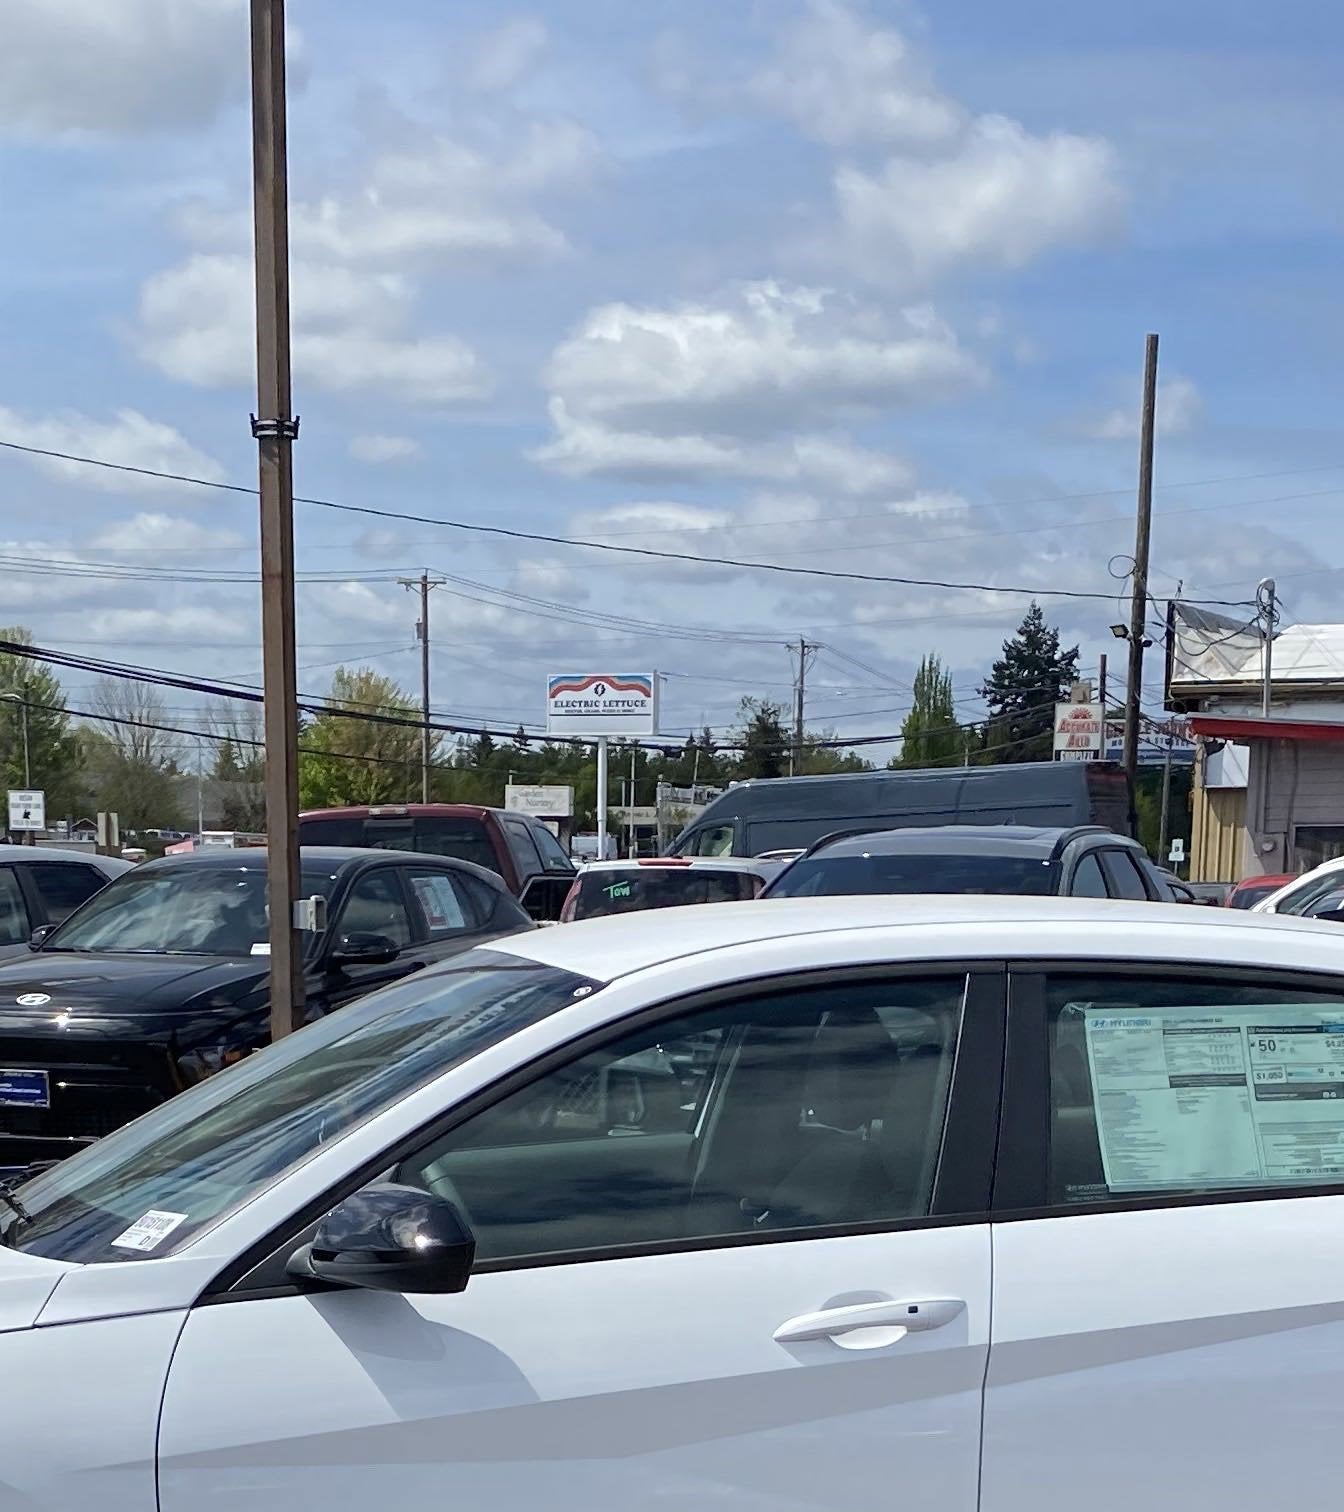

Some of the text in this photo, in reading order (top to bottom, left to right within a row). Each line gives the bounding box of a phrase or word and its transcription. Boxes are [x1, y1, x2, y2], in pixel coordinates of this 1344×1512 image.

[554, 699, 647, 708] ELECTRIC LETTUCE
[1258, 1039, 1276, 1052] 50
